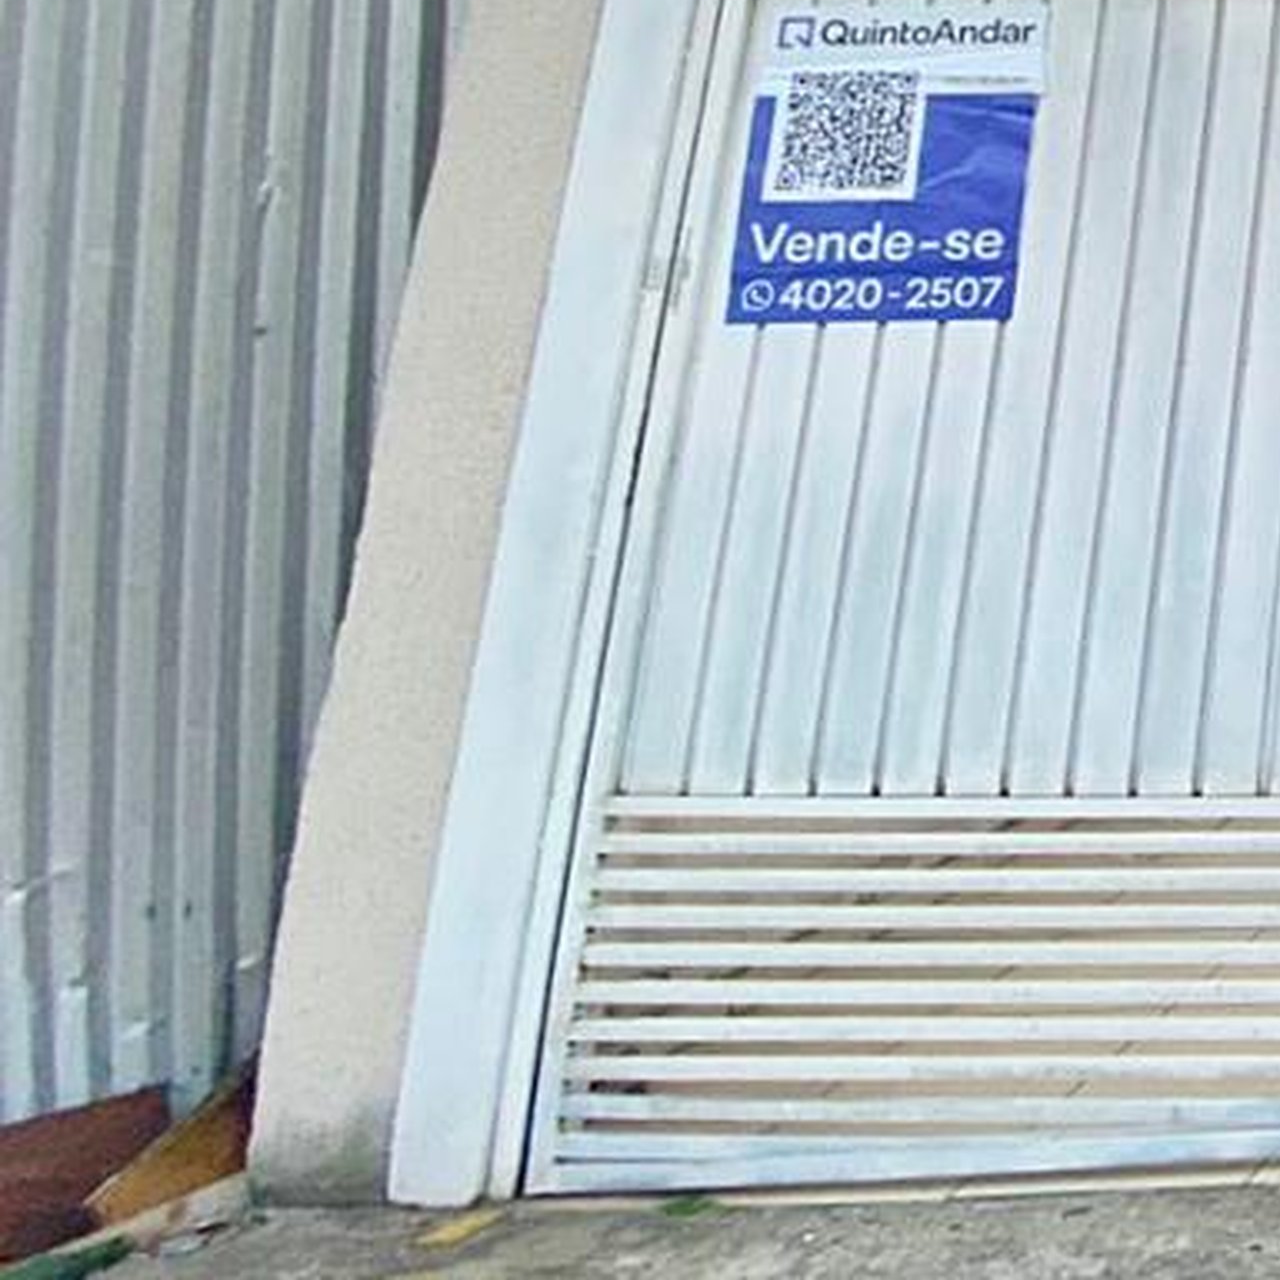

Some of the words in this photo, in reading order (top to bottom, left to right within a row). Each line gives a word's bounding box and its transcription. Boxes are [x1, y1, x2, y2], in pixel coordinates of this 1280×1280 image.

[820, 19, 1037, 47] QuintoAndar
[751, 220, 1006, 263] Vende-se
[778, 277, 1004, 311] 4020-2507
